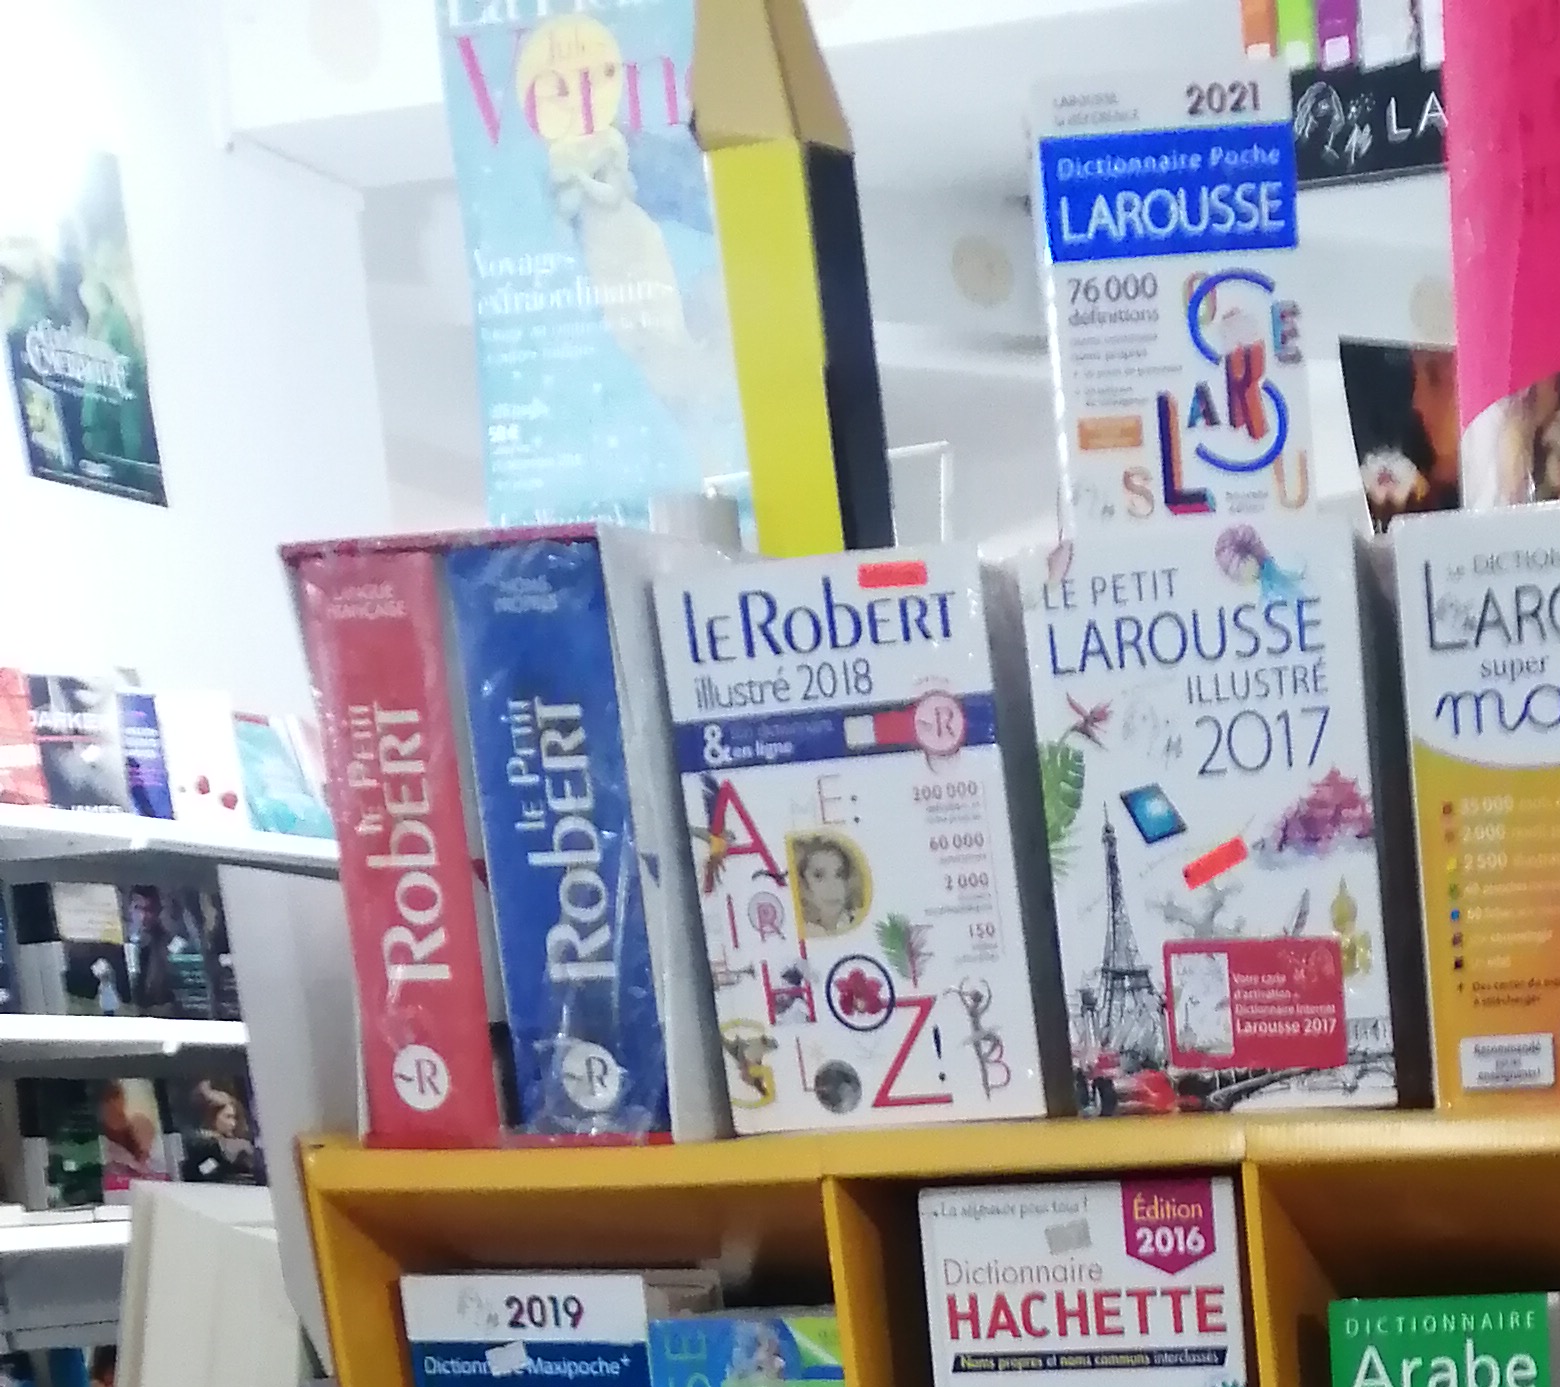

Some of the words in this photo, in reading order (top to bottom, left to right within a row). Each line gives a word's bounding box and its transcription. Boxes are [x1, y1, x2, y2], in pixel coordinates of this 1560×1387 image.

[455, 36, 696, 148] Vern
[1186, 80, 1261, 117] 2021
[1056, 147, 1201, 178] Dictionnaire
[1210, 143, 1281, 170] Poche
[1060, 184, 1285, 245] LAROUSSE
[1043, 578, 1078, 611] LE
[1091, 567, 1179, 606] PETIT
[1047, 594, 1327, 678] LAROUSSE
[694, 670, 791, 711] illustré
[800, 658, 873, 702] 2018
[1186, 655, 1329, 706] ILLUSTRÉ
[1195, 704, 1331, 778] 2017
[1235, 1016, 1300, 1037] Larousse
[1303, 1016, 1338, 1035] 2017
[1133, 1193, 1204, 1223] Édition
[1135, 1225, 1207, 1258] 2016
[943, 1257, 1104, 1287] Dictionnaire
[505, 1294, 584, 1330] 2019
[945, 1284, 1228, 1342] HACHETTE
[1345, 1310, 1538, 1336] DICTIONNAIRE
